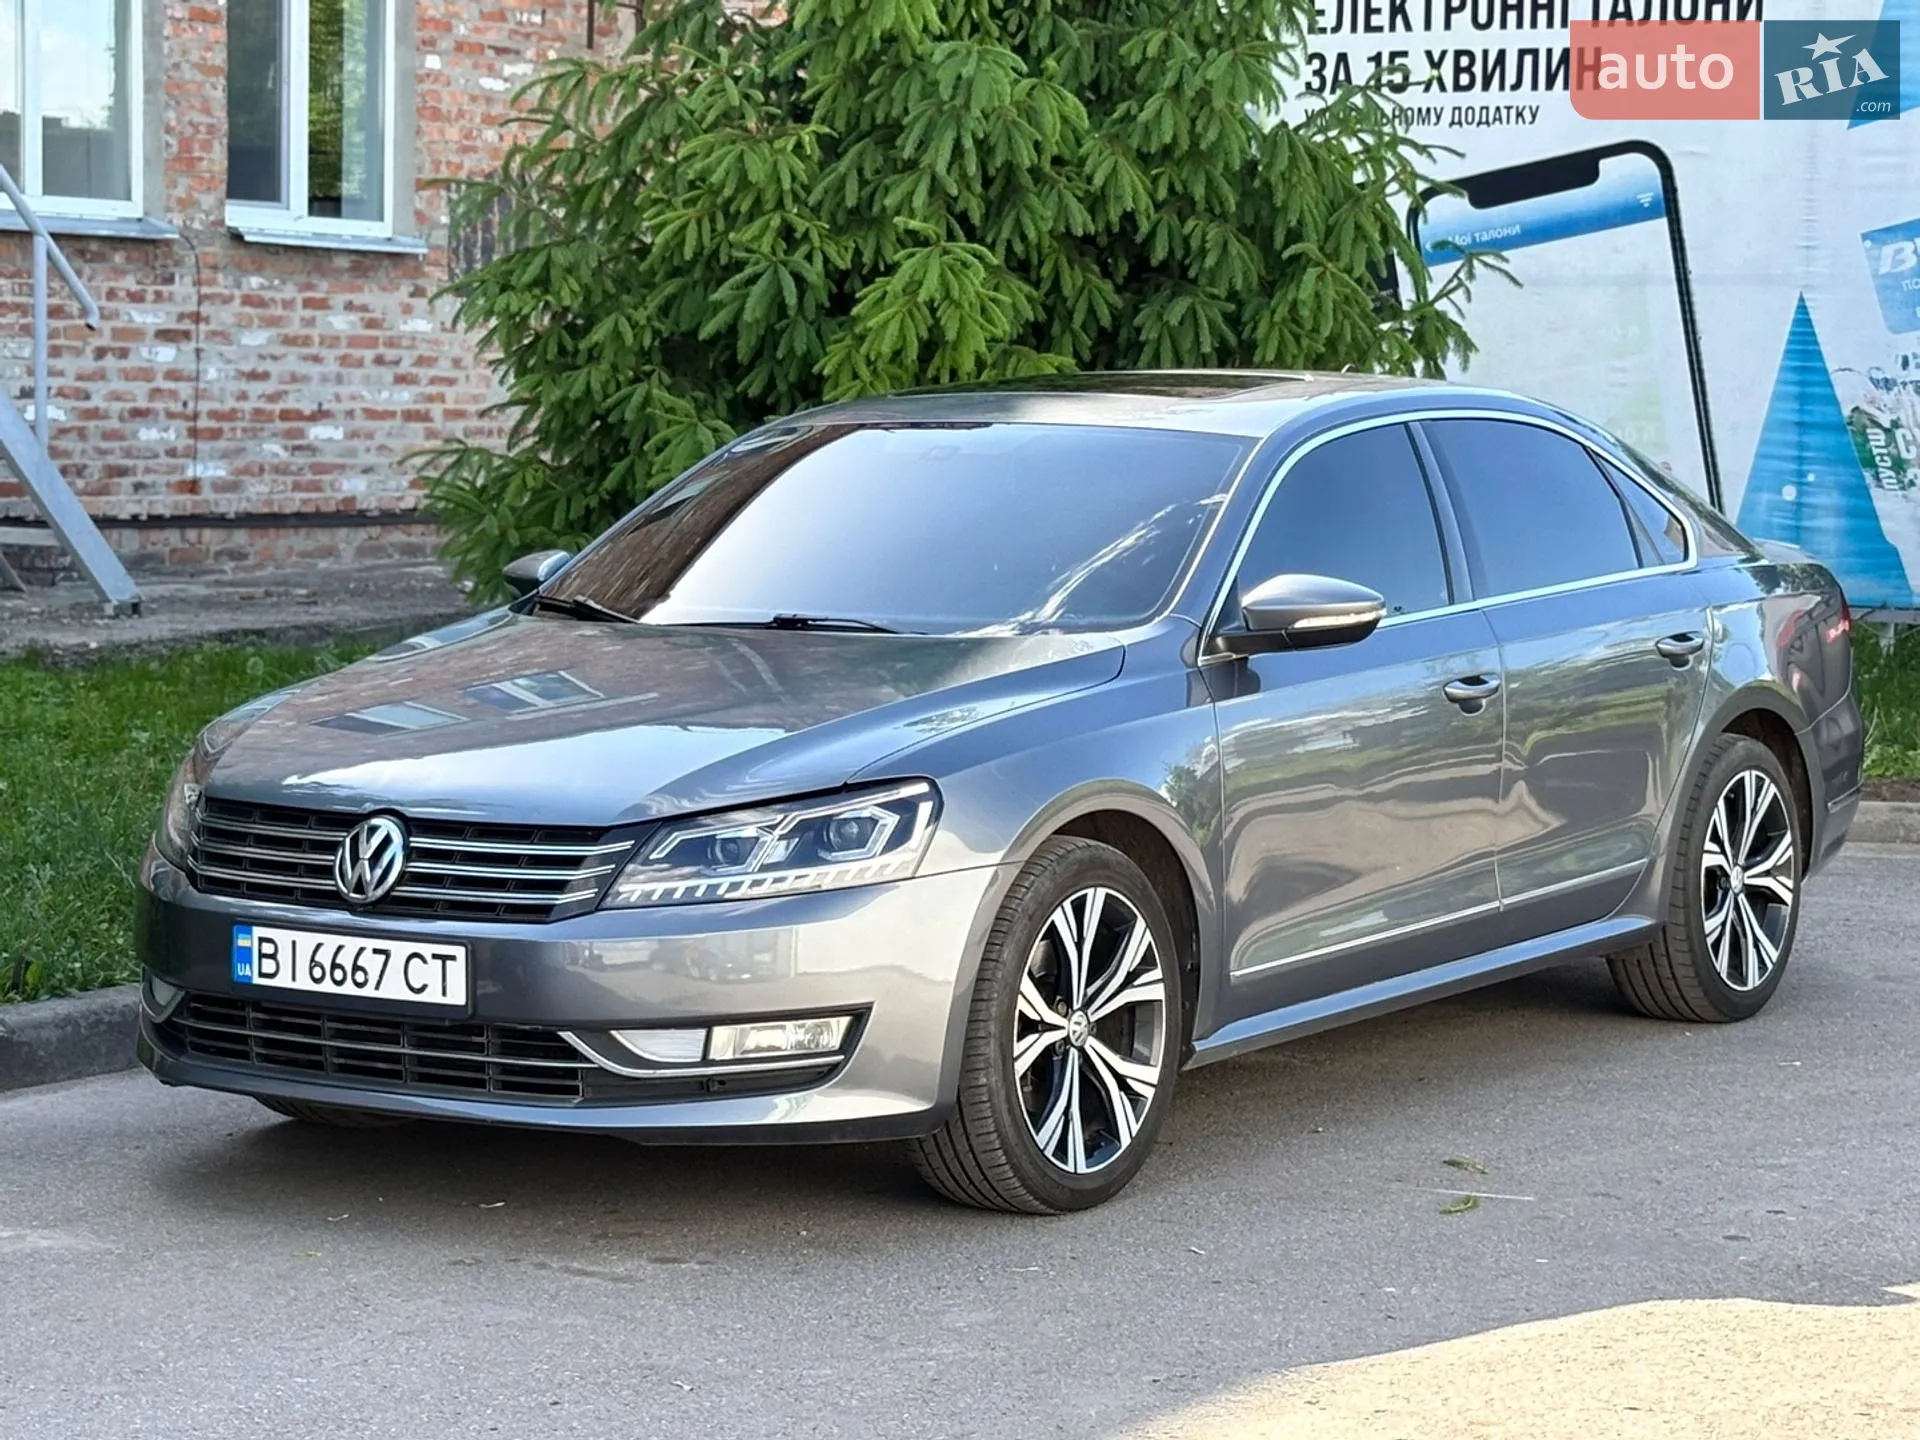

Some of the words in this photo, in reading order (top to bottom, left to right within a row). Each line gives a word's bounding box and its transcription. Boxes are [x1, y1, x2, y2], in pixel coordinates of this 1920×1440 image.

[1305, 52, 1353, 96] ЗА
[1367, 50, 1410, 94] 15
[1422, 46, 1602, 94] ХВИЛИН
[1448, 104, 1540, 128] ДОДАТКУ
[1473, 224, 1520, 243] талони
[237, 962, 252, 977] UA
[404, 951, 457, 997] CT
